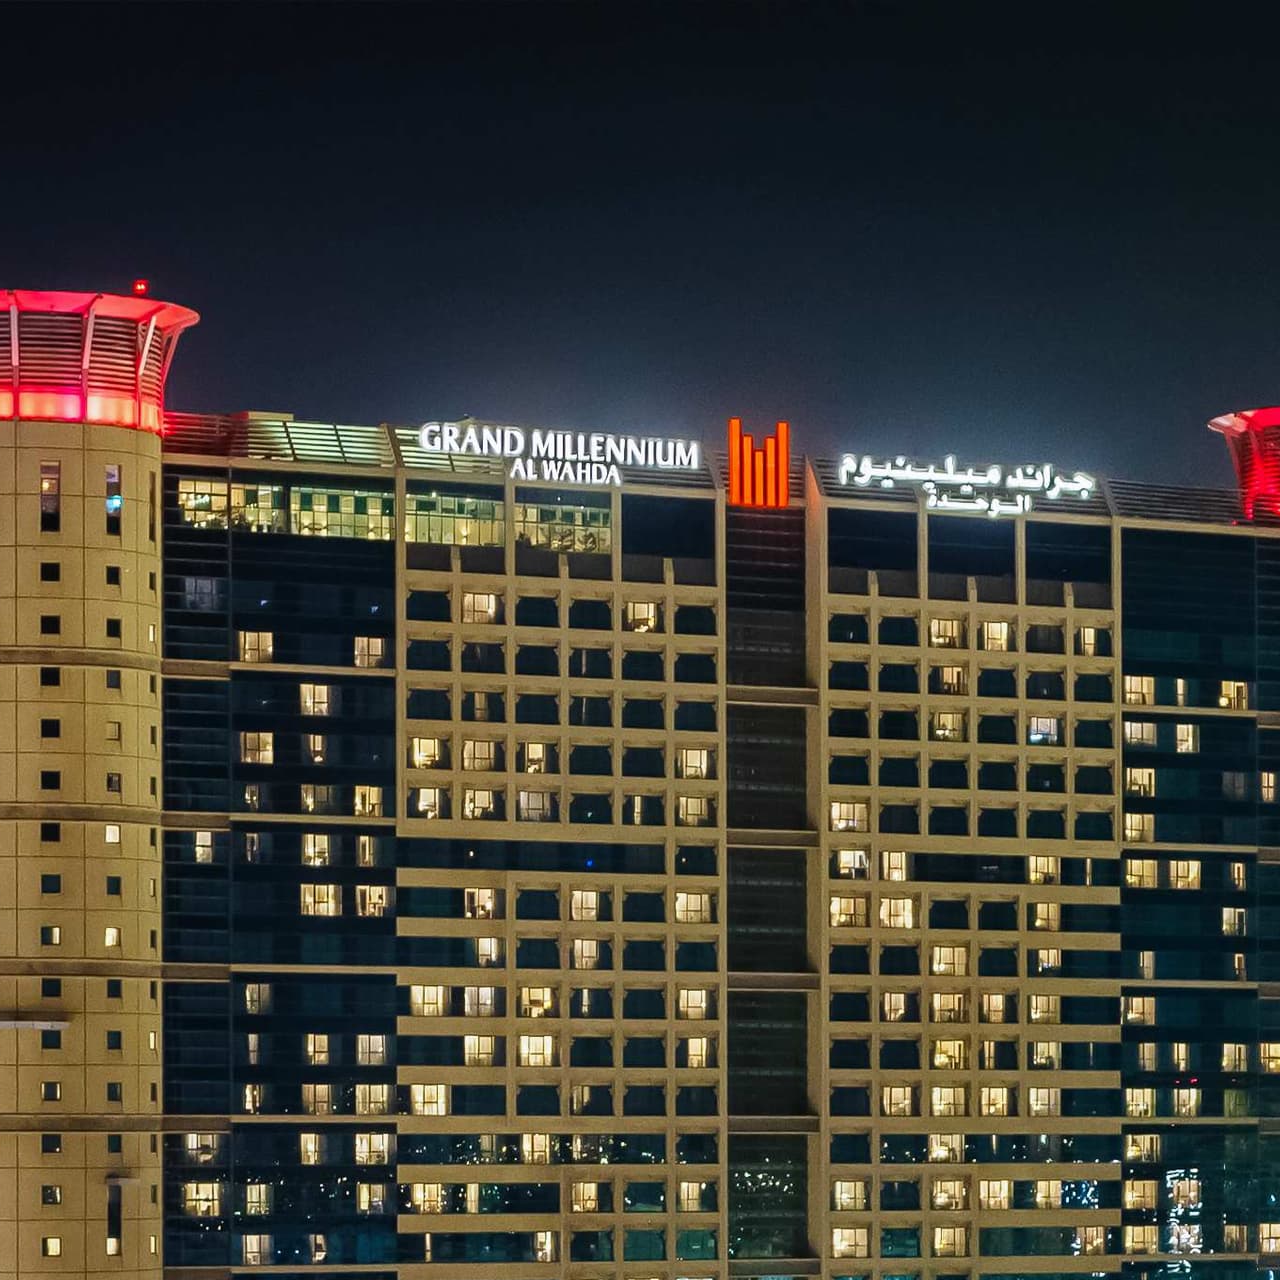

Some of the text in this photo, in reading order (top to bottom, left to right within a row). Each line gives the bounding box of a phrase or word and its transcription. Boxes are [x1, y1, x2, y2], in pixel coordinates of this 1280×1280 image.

[419, 422, 701, 470] GRAND MILLENNIUM
[509, 457, 622, 486] AL WAHDA
[838, 454, 1096, 499] جراند ميلينيوم
